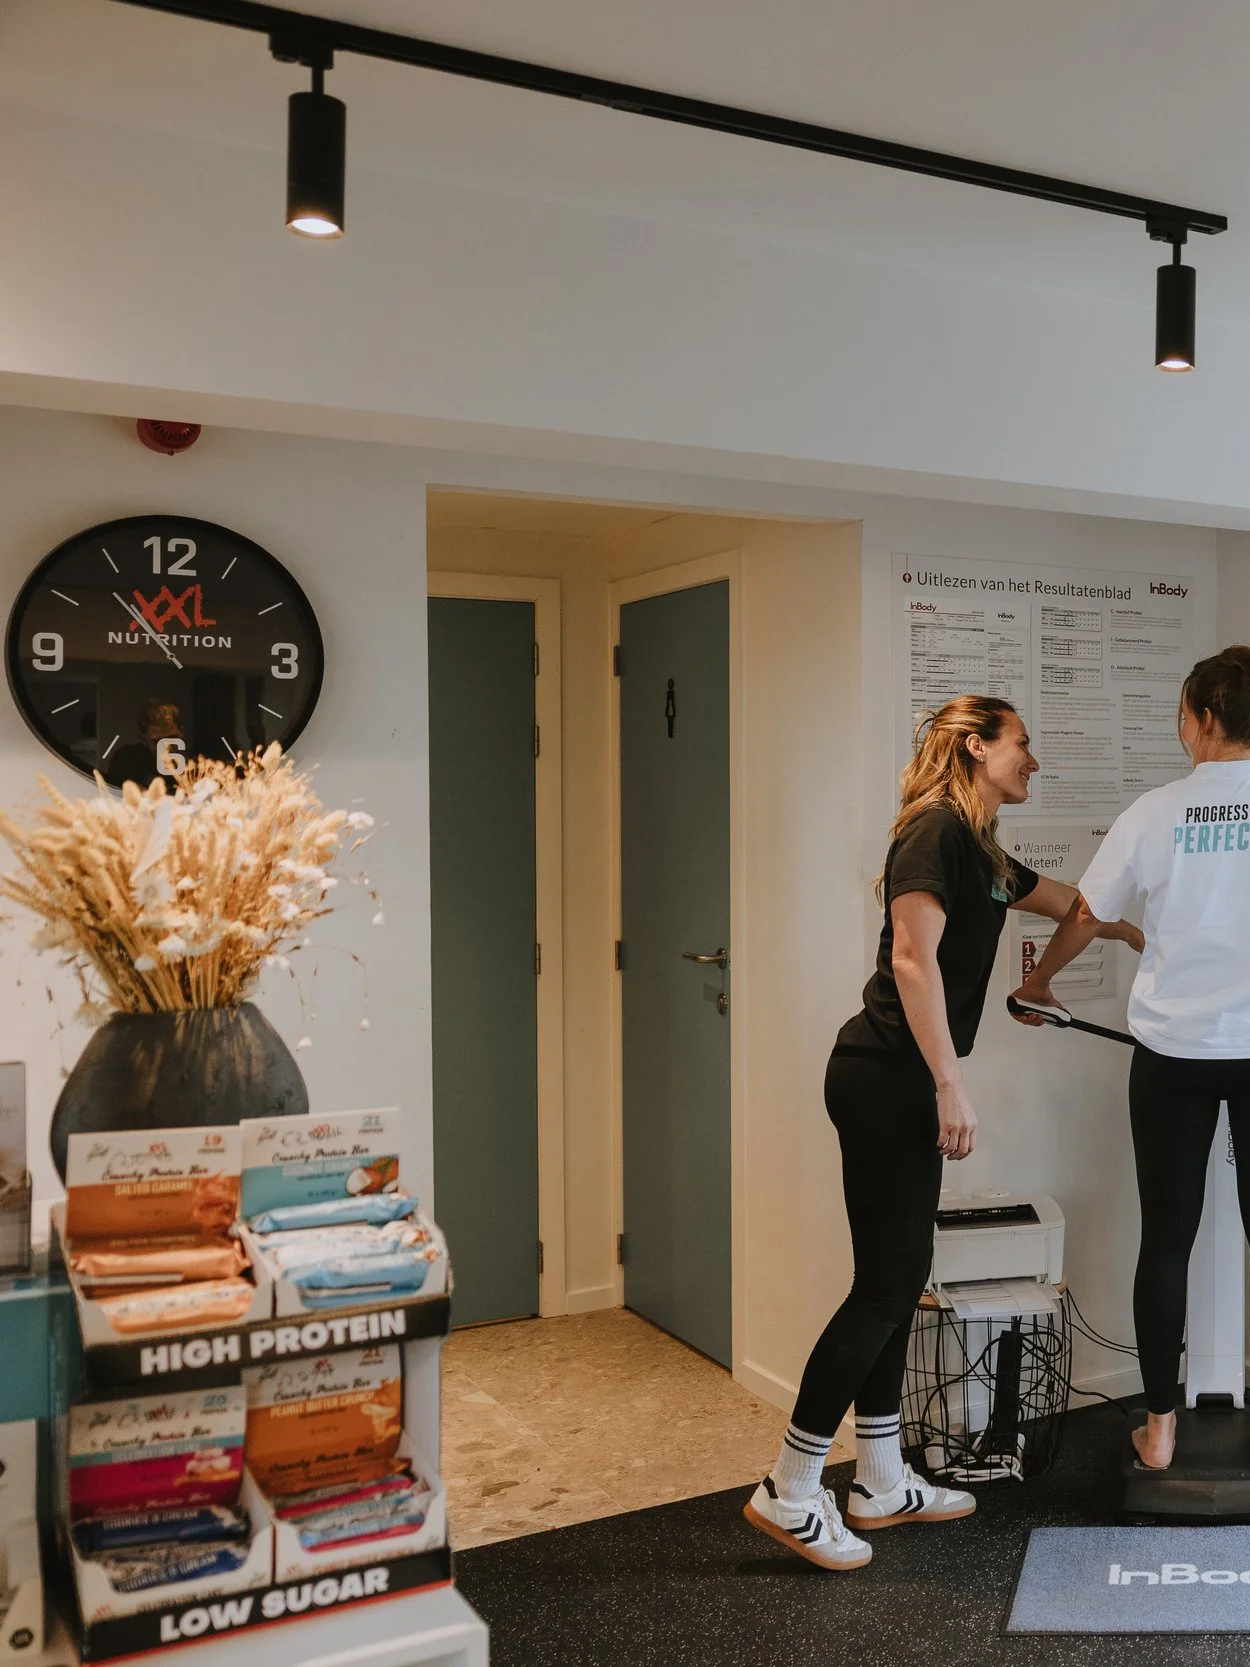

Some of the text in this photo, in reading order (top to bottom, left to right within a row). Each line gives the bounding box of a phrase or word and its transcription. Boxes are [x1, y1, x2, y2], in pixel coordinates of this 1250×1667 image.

[143, 536, 197, 577] 12
[917, 571, 1131, 600] Uitlezen van het Resultatenblad
[1149, 582, 1188, 598] InBody
[129, 583, 217, 633] XXL
[910, 602, 937, 613] InBody
[997, 612, 1015, 620] InBody
[108, 631, 232, 649] NUTRITION
[32, 632, 64, 672] 9
[270, 642, 299, 680] 3
[156, 738, 186, 776] 6
[1185, 803, 1249, 823] PROGRESS
[1023, 842, 1072, 853] Wanneer
[1024, 856, 1064, 868] Meten?
[1024, 943, 1032, 955] 1
[1024, 960, 1032, 972] 2
[140, 1309, 406, 1376] HIGH PROTEIN
[160, 1596, 254, 1642] LOW
[261, 1567, 390, 1619] SUGAR
